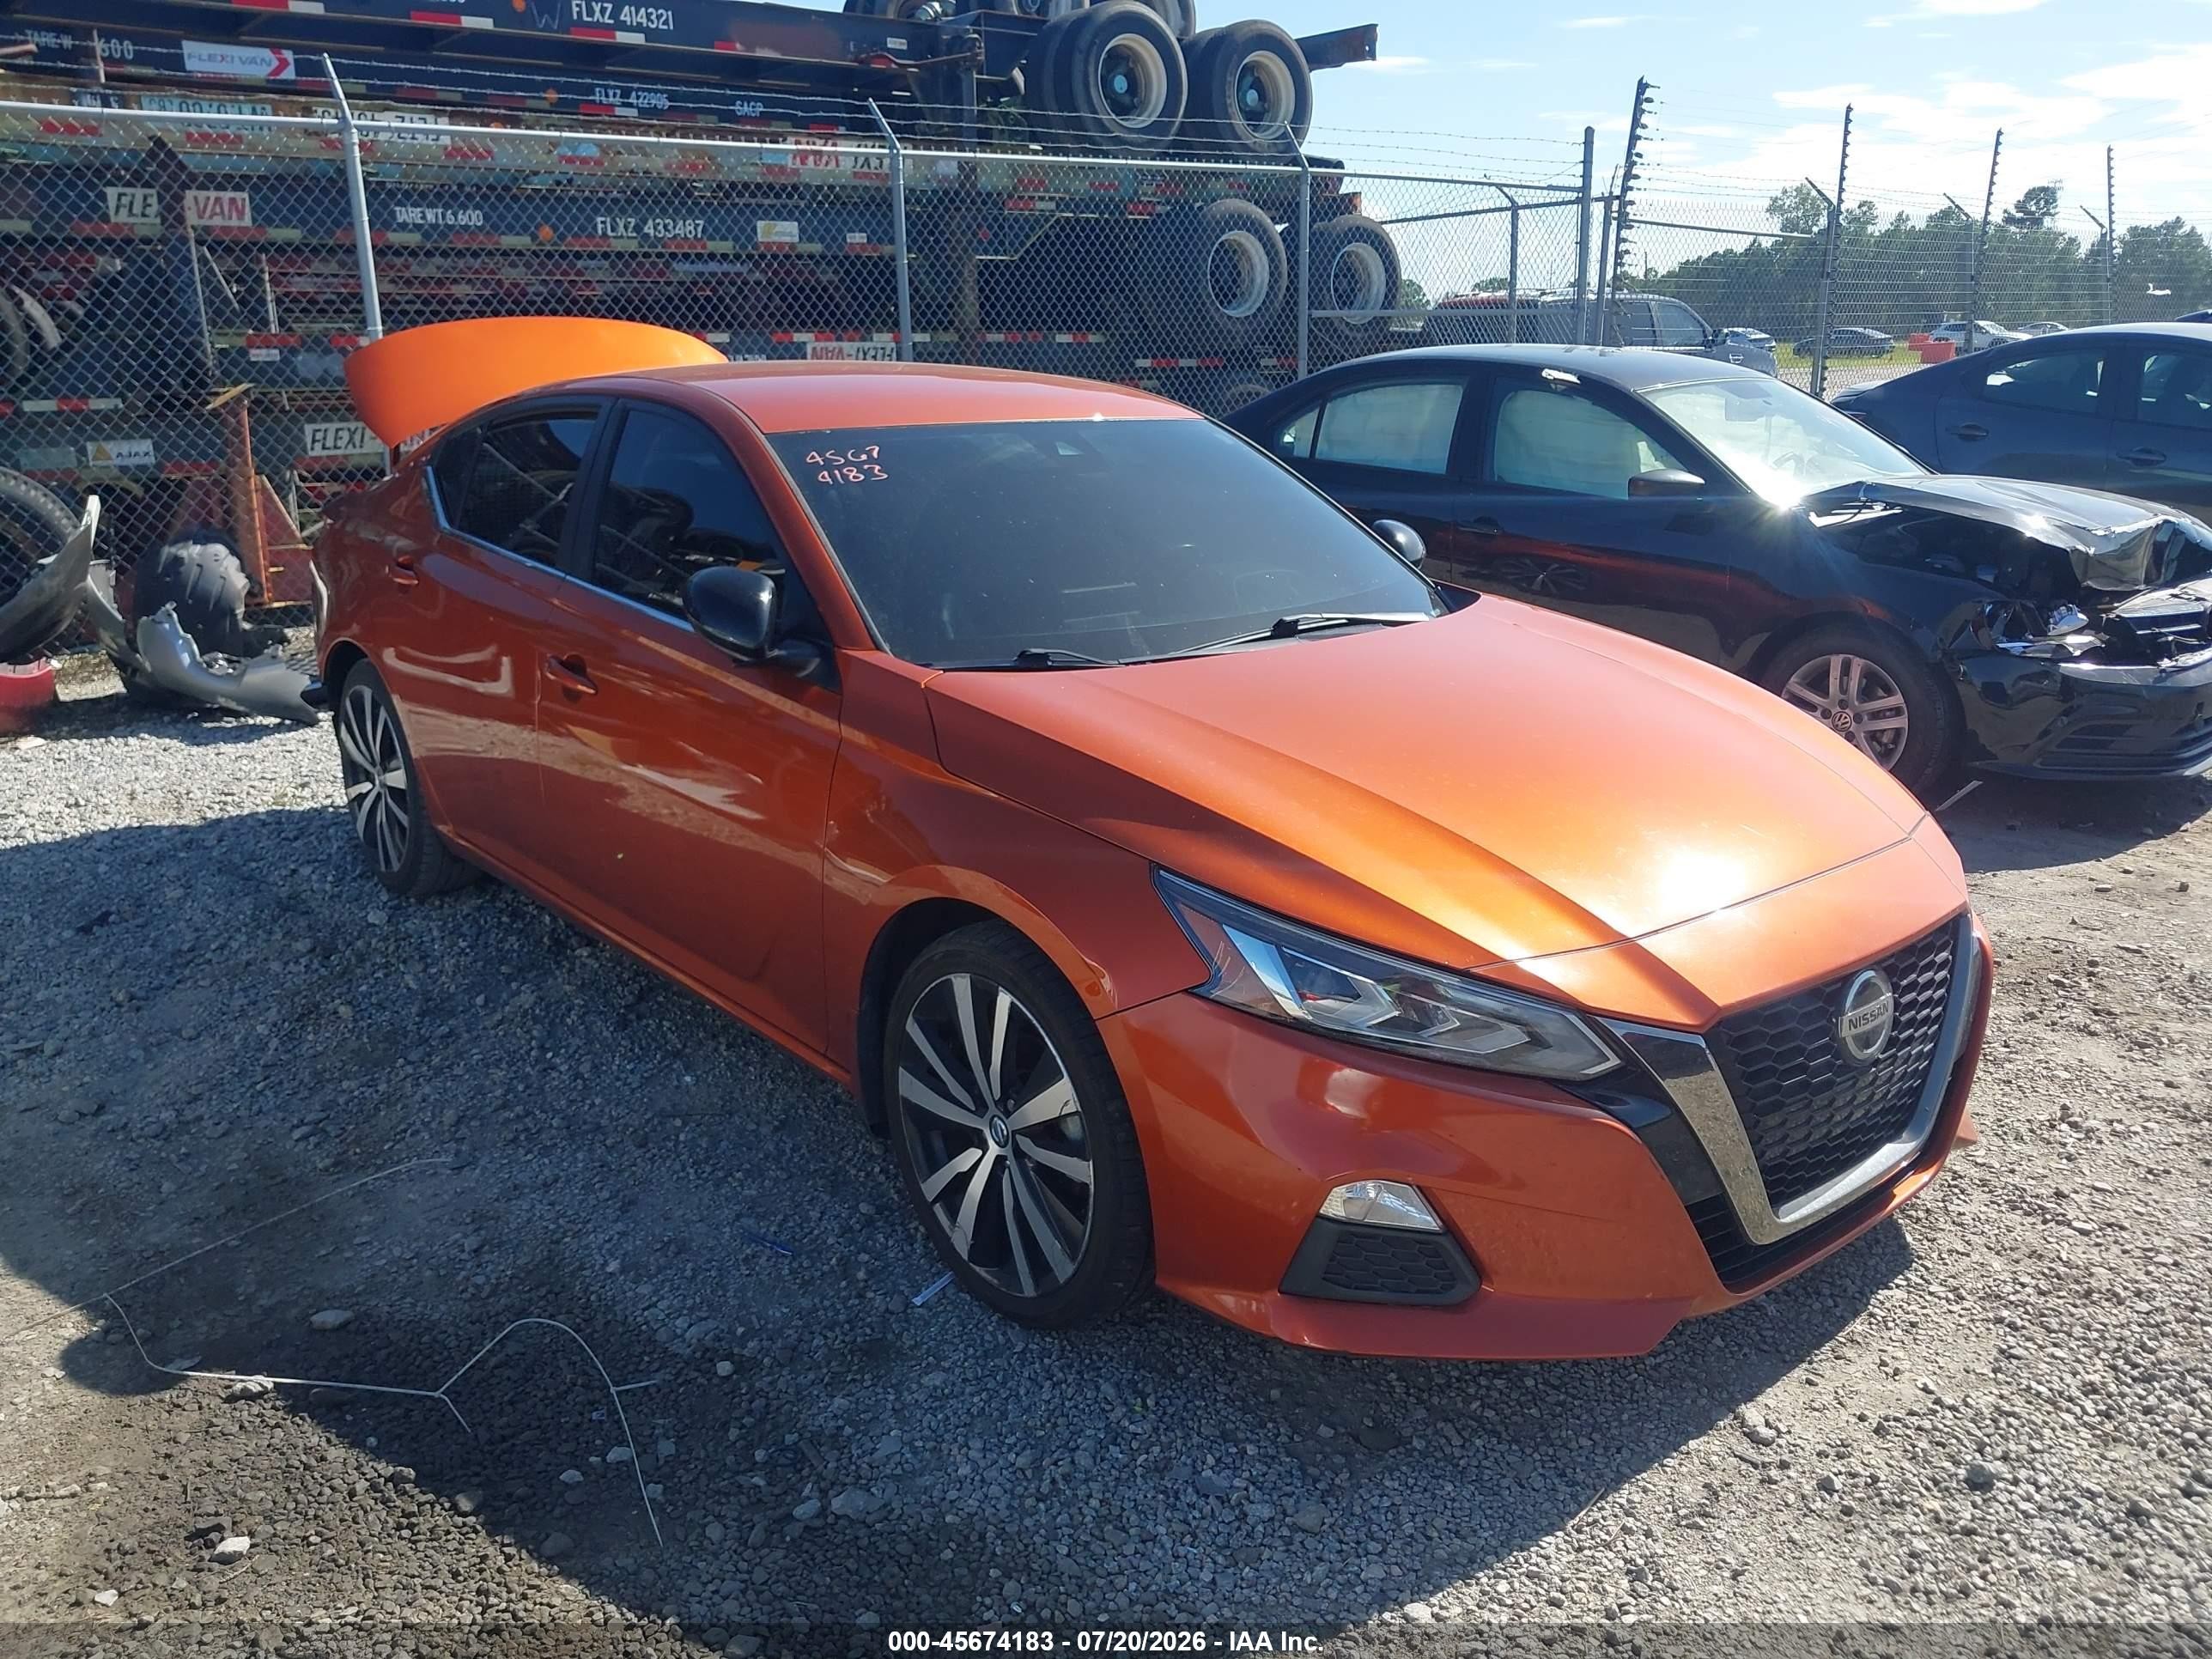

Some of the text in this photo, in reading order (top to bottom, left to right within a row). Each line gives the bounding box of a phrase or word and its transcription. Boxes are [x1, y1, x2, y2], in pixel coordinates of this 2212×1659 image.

[571, 0, 674, 30] FLXZ 414321
[188, 52, 271, 67] FLEXI VAN
[394, 207, 424, 223] TARE
[596, 216, 704, 238] FLXZ 433487
[1848, 1000, 1889, 1031] NISSAN
